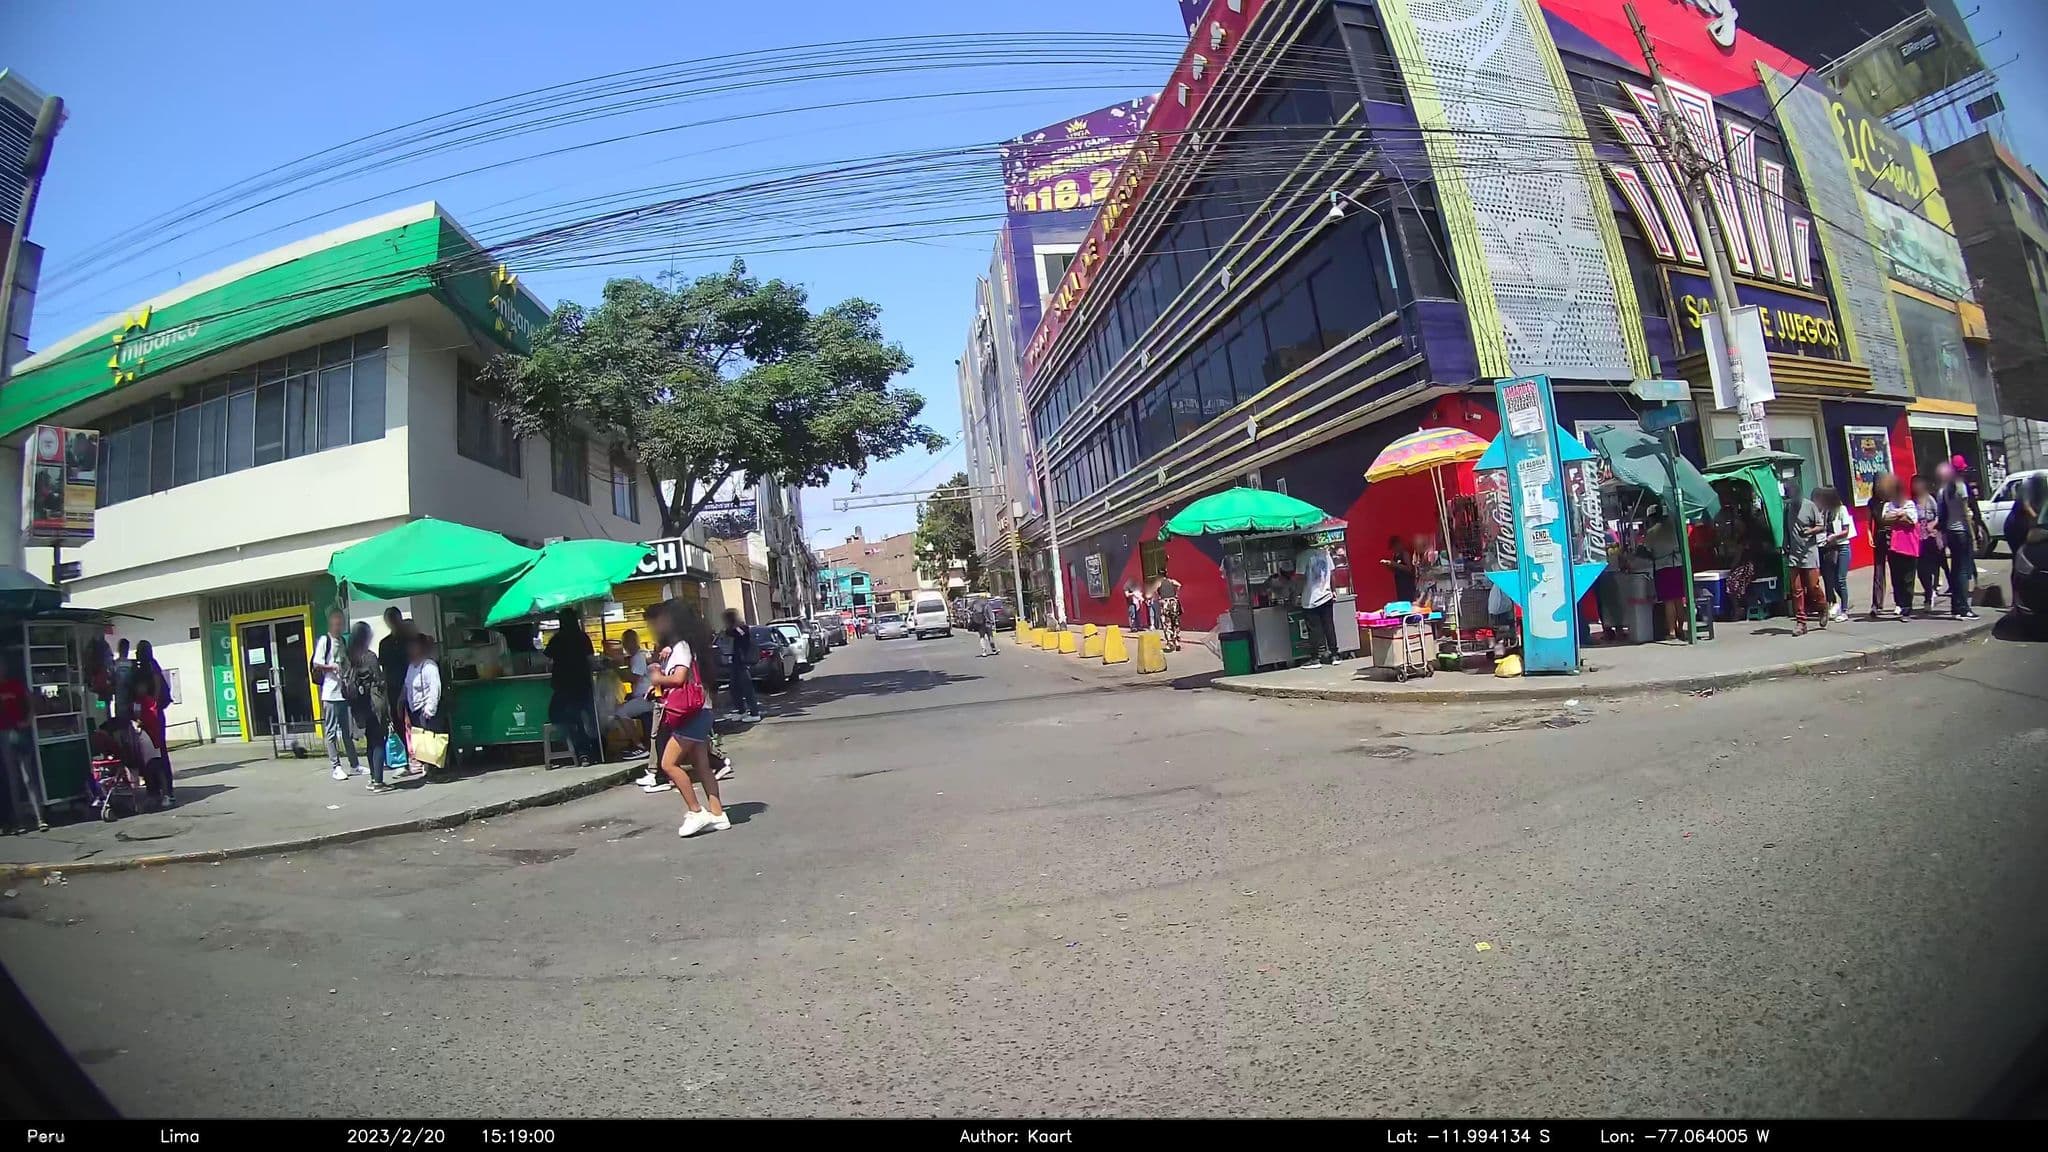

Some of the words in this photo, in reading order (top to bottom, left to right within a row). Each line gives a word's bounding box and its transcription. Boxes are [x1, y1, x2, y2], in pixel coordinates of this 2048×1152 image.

[1759, 306, 1774, 337] E
[1776, 309, 1840, 348] JUEGOS
[221, 636, 238, 719] GIROS
